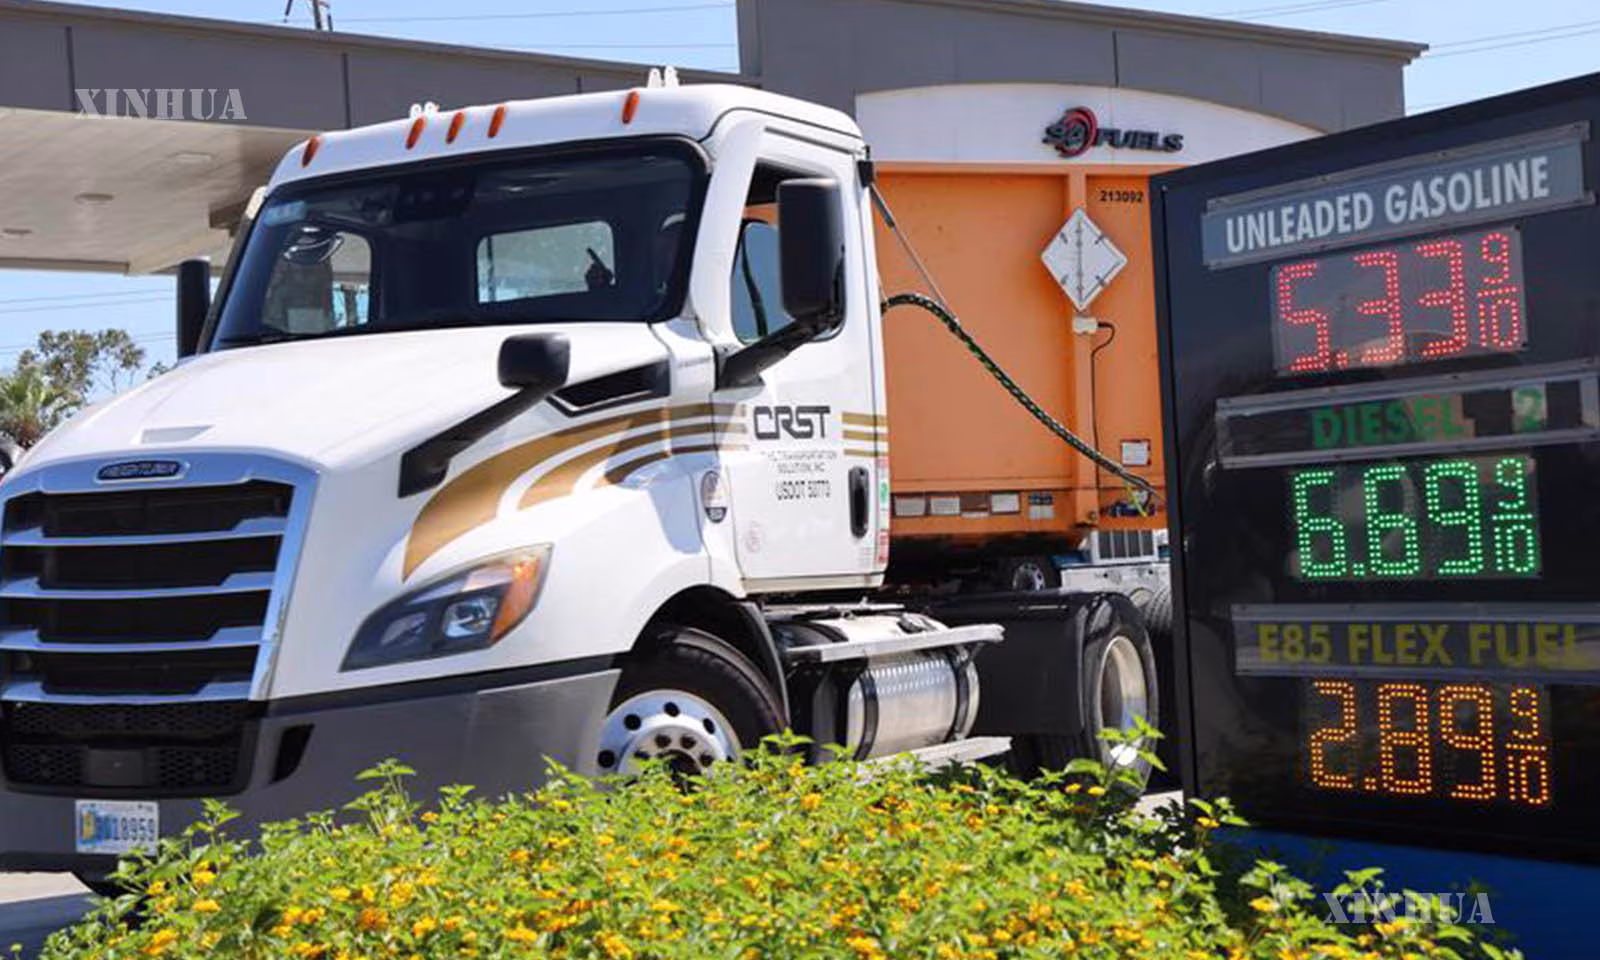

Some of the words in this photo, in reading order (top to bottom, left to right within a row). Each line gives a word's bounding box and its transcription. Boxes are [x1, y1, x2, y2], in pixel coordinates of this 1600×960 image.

[1093, 128, 1184, 152] FUELS
[1100, 190, 1144, 203] 213092
[1226, 192, 1373, 254] UNLEADED
[1385, 155, 1550, 224] GASOLINE
[1276, 239, 1469, 372] 5.33
[753, 405, 831, 440] CRST
[1313, 394, 1467, 449] DIESEL
[1515, 388, 1544, 432] 2
[1294, 460, 1484, 577] 6.69
[1257, 623, 1332, 662] E85
[1348, 623, 1455, 665] FLEX
[1468, 622, 1592, 671] FUEL
[1309, 681, 1497, 801] 2.89
